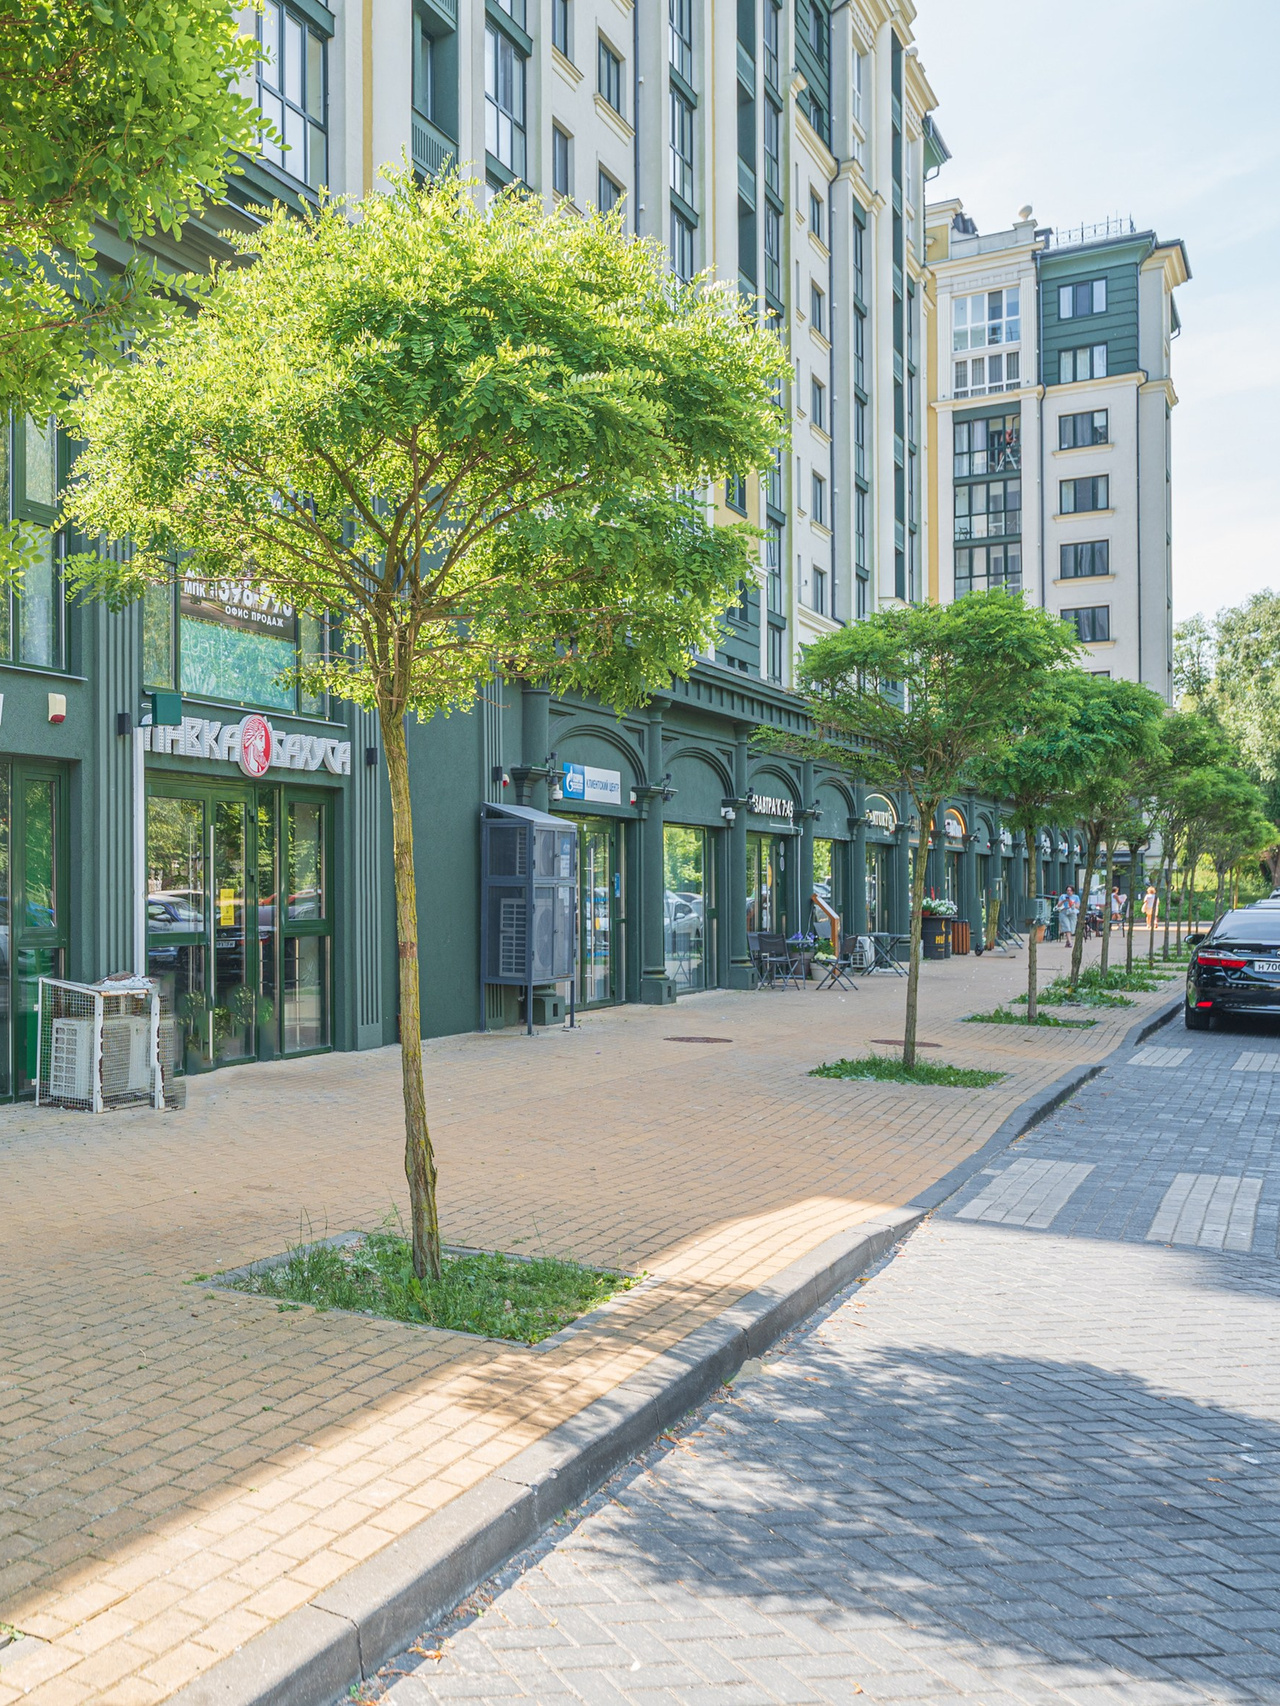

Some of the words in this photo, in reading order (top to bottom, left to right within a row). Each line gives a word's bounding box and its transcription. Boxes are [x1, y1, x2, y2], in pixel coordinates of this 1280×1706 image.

[225, 606, 249, 619] ОФИС
[251, 612, 284, 628] ПРОДАЖ
[269, 729, 351, 775] БАХУСА
